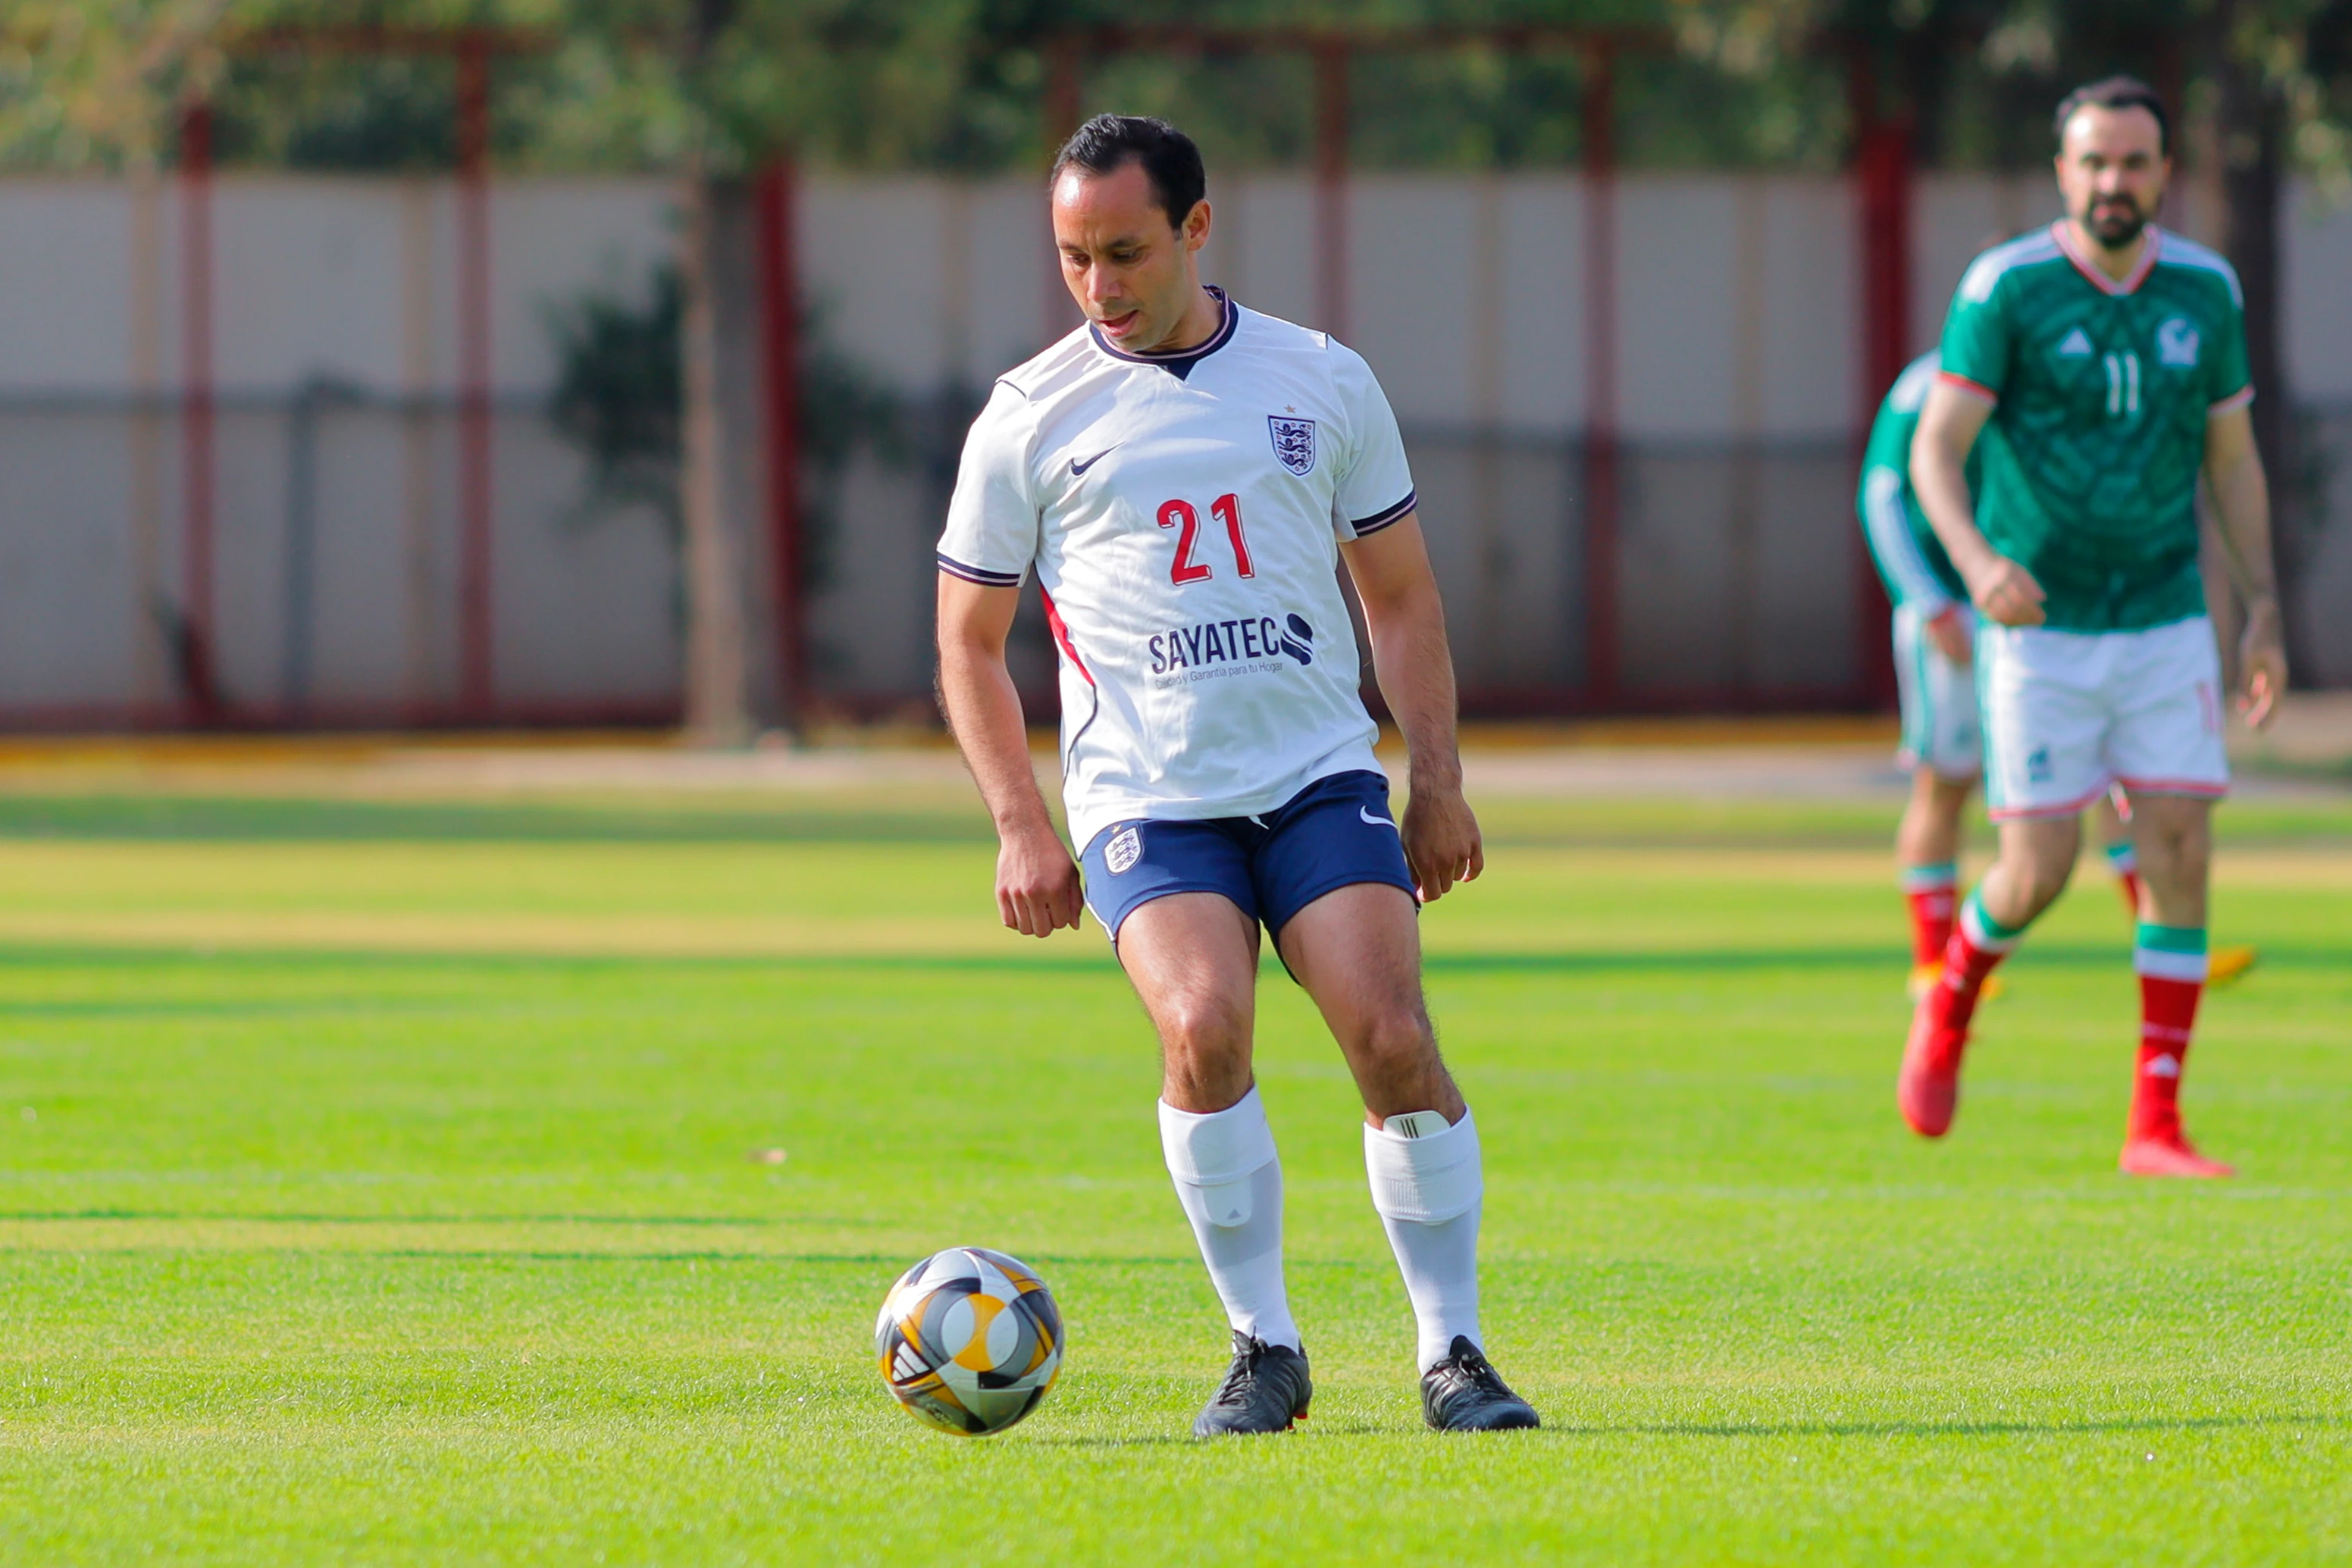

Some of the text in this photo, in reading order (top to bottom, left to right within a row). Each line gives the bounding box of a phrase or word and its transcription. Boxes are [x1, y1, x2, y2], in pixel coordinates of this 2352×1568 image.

[2103, 352, 2141, 414] 11
[1157, 493, 1255, 586] 21
[1149, 617, 1279, 674] SAYATEC
[1228, 665, 1247, 677] para
[1249, 664, 1257, 673] tu
[1259, 662, 1282, 673] Hogar
